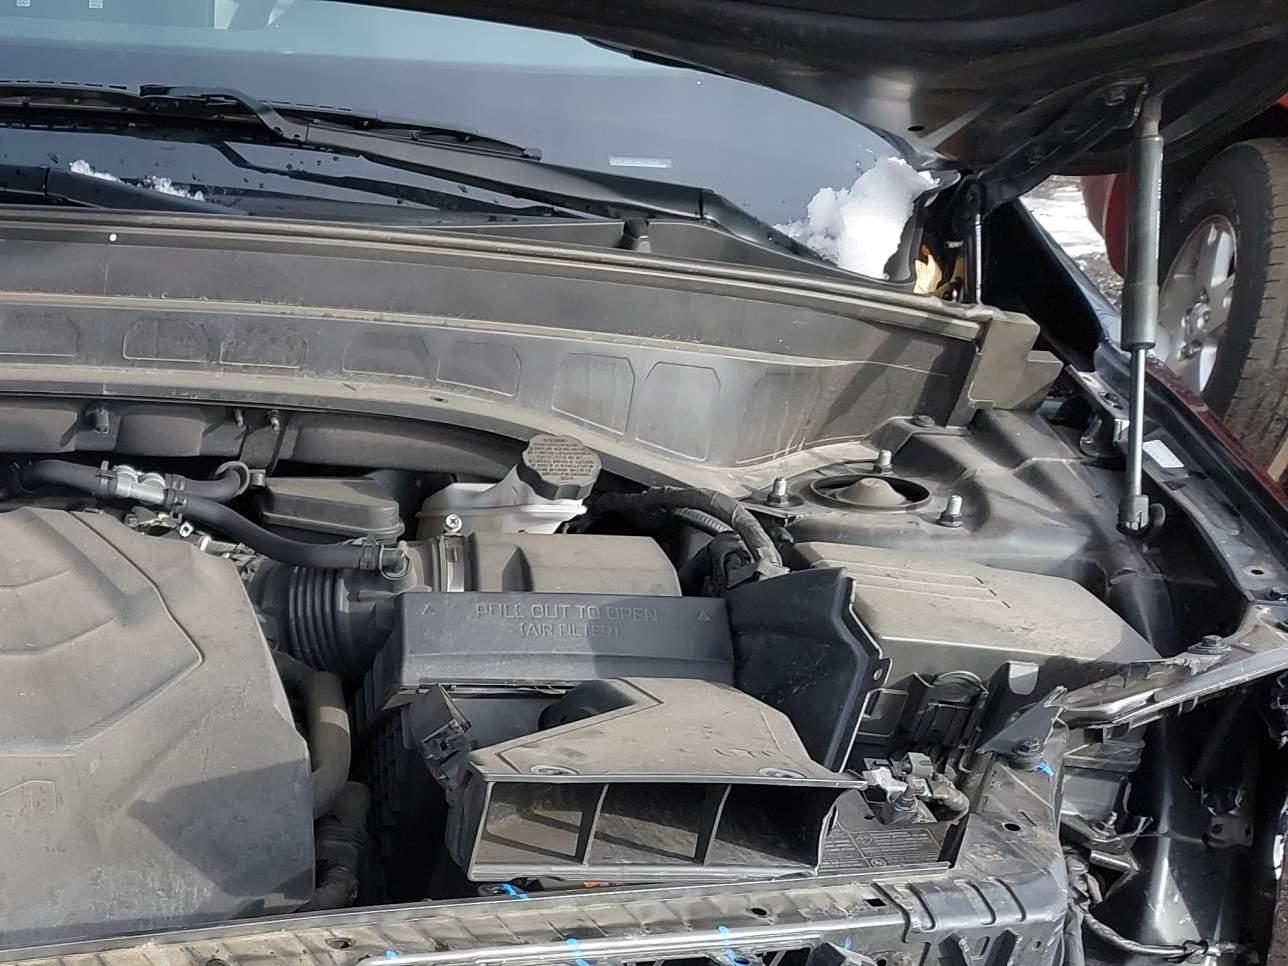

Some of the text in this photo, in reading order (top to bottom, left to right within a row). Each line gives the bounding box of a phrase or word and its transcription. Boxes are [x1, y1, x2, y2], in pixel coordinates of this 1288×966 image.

[475, 602, 658, 622] PULL OUT TO OPEN
